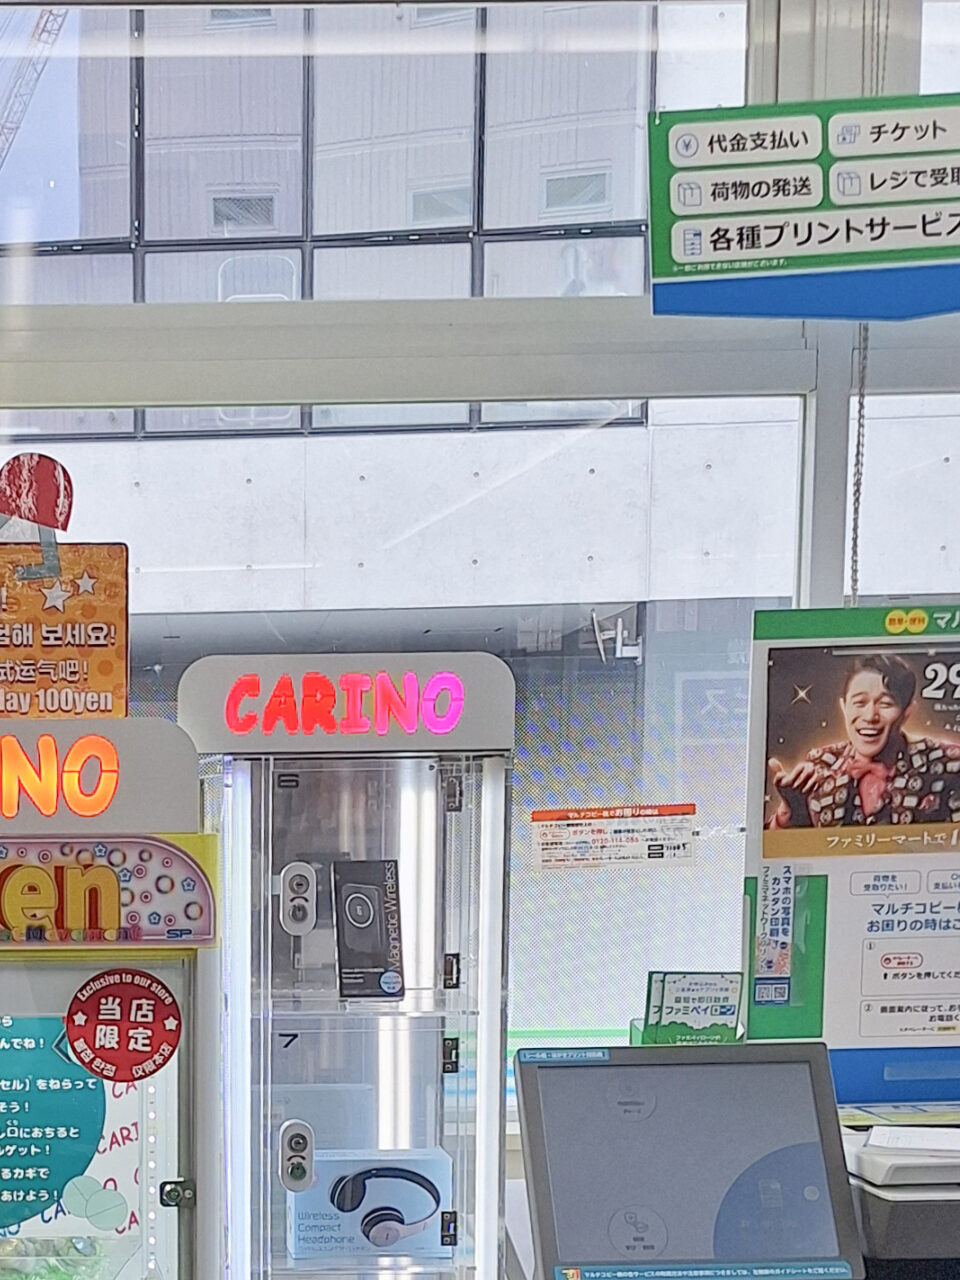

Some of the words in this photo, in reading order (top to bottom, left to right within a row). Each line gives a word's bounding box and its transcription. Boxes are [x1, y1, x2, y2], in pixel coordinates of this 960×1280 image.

[707, 130, 809, 154] 代金支払い
[869, 119, 947, 143] チケット
[710, 176, 813, 201] 荷物の発送
[40, 622, 116, 647] 보세요!
[35, 687, 113, 713] 100yen
[224, 670, 465, 737] CARINO
[383, 862, 397, 912] Wireless
[167, 928, 192, 939] SP
[385, 914, 401, 971] Magnetic
[76, 973, 121, 1002] Exclusive
[122, 973, 132, 983] to
[133, 975, 152, 988] our
[150, 982, 174, 1005] store
[278, 1033, 299, 1049] 7
[297, 1210, 340, 1221] Wireless
[297, 1223, 342, 1233] Compact
[297, 1234, 356, 1245] Headphone
